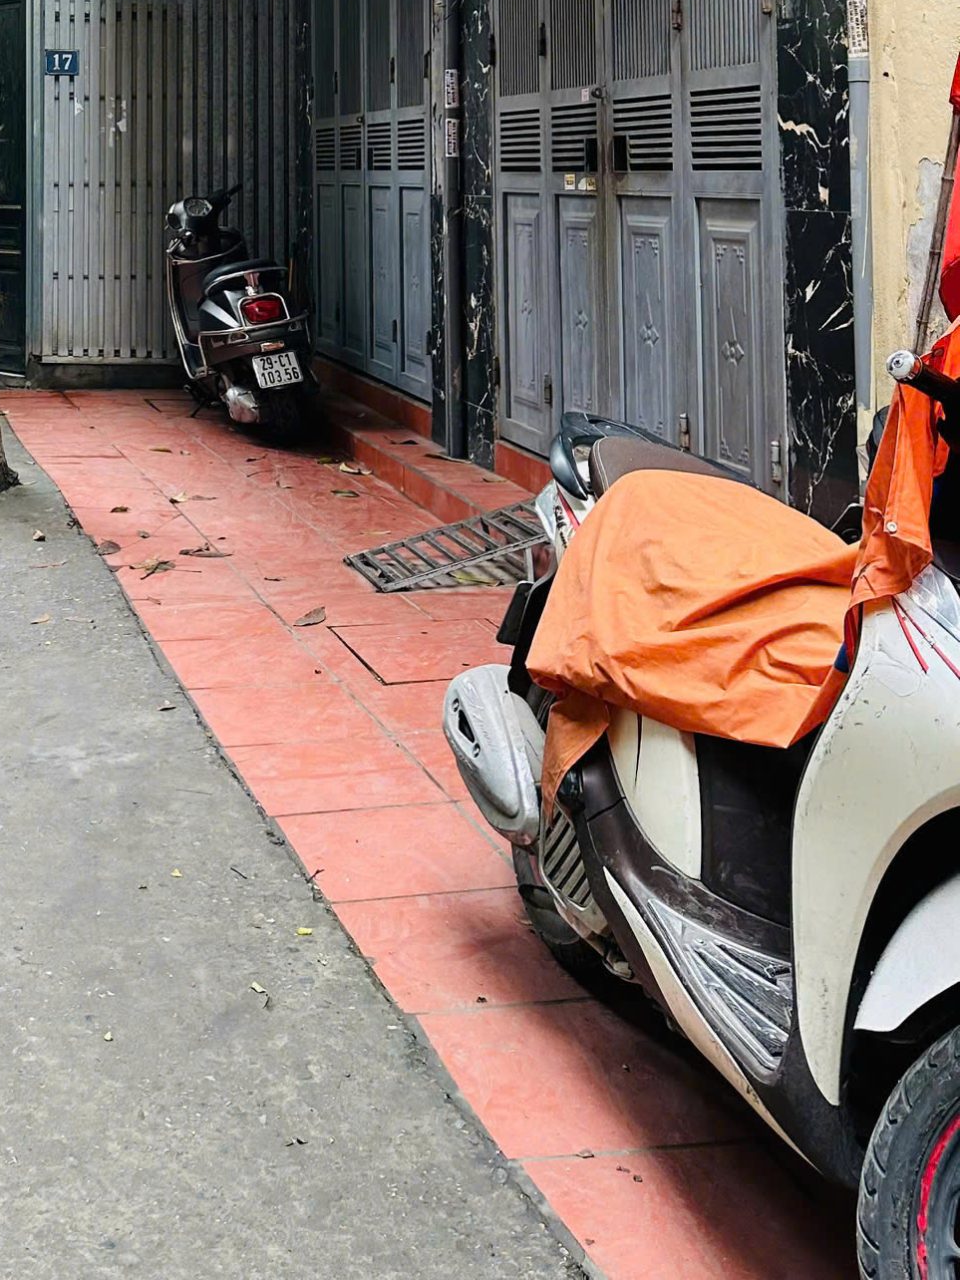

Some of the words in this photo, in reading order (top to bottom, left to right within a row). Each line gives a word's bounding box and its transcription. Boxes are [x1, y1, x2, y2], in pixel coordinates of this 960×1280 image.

[53, 54, 73, 70] 17
[260, 354, 292, 371] 29-C1
[261, 367, 300, 386] 103.56
